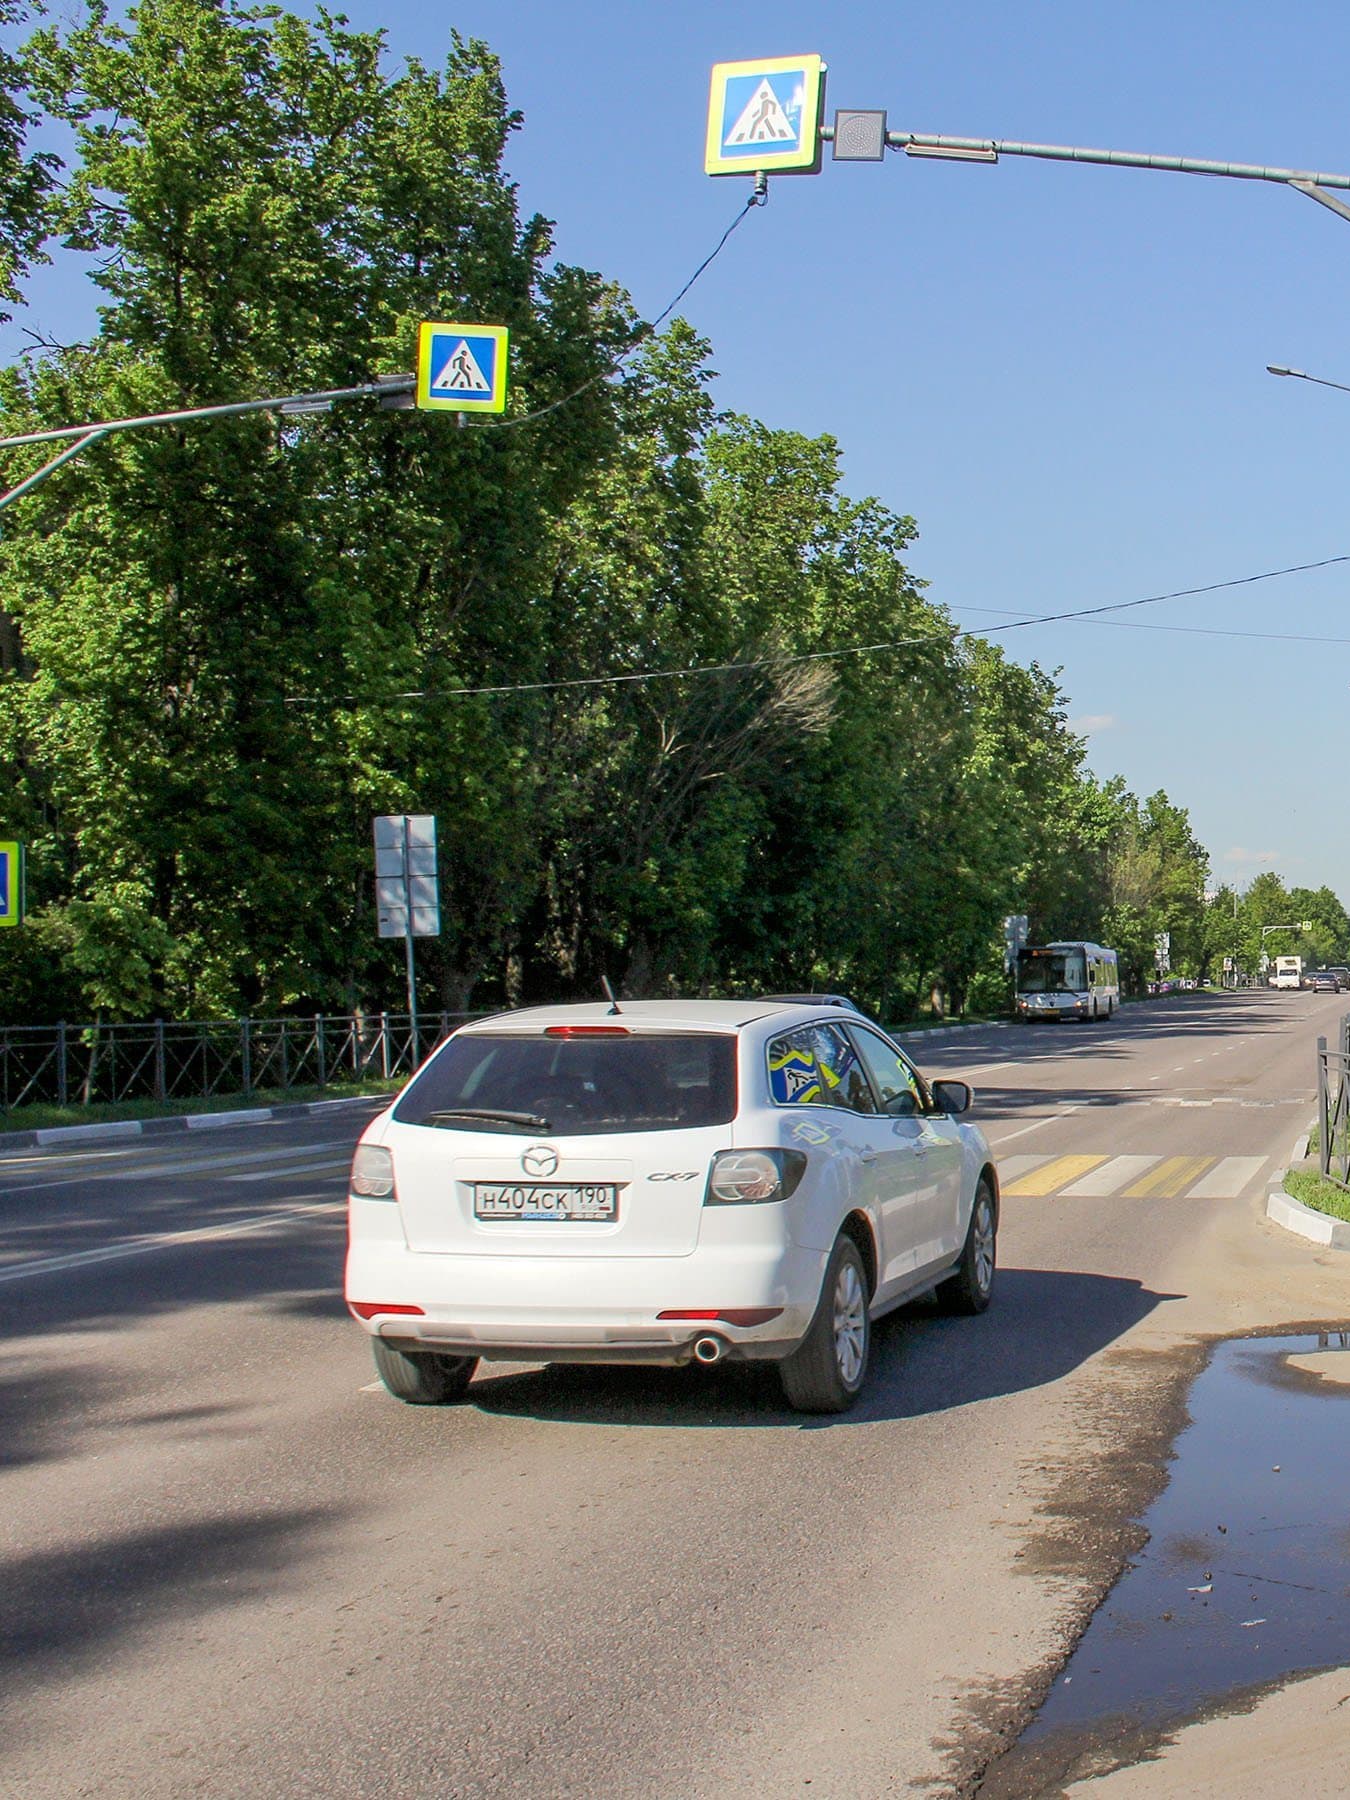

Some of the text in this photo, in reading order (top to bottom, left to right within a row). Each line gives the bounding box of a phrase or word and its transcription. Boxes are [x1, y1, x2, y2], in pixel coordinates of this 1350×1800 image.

[646, 1172, 699, 1181] CX-7
[483, 1186, 607, 1209] Н404СК 190
